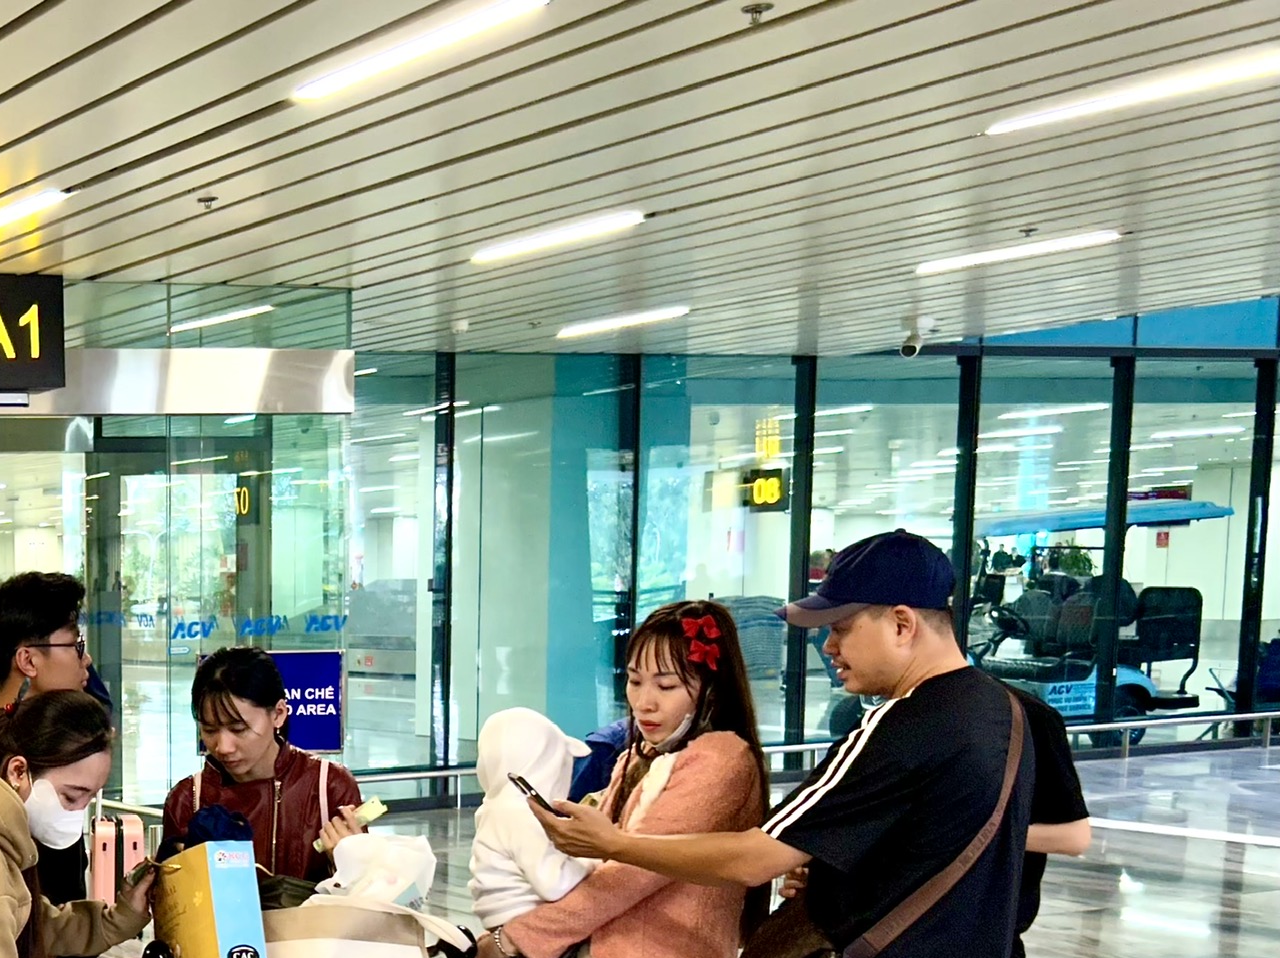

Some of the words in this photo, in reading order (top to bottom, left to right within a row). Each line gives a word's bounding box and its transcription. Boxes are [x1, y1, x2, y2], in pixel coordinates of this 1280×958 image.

[172, 620, 215, 640] ACV
[239, 615, 280, 637] ACV
[304, 614, 348, 633] ACV
[1048, 684, 1073, 696] ACV
[296, 703, 337, 716] AREA
